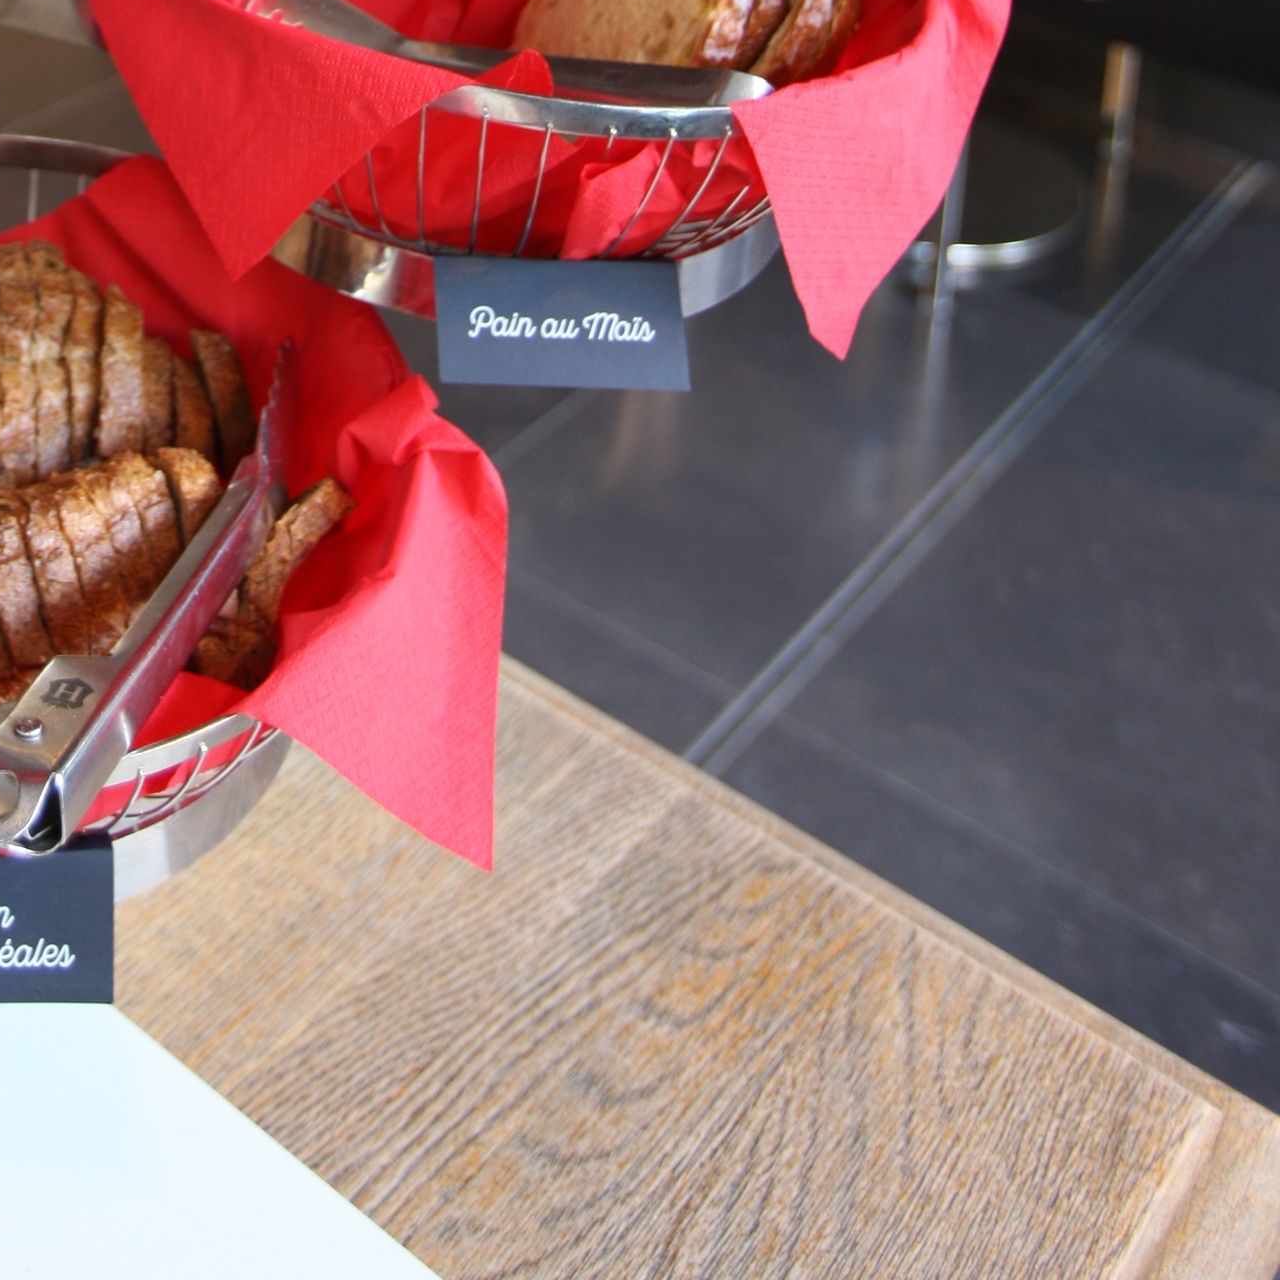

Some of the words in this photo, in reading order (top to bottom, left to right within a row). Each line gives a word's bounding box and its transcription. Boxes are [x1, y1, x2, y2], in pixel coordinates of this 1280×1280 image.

[468, 305, 536, 338] Pain
[540, 317, 580, 339] au
[581, 311, 656, 342] Maïs
